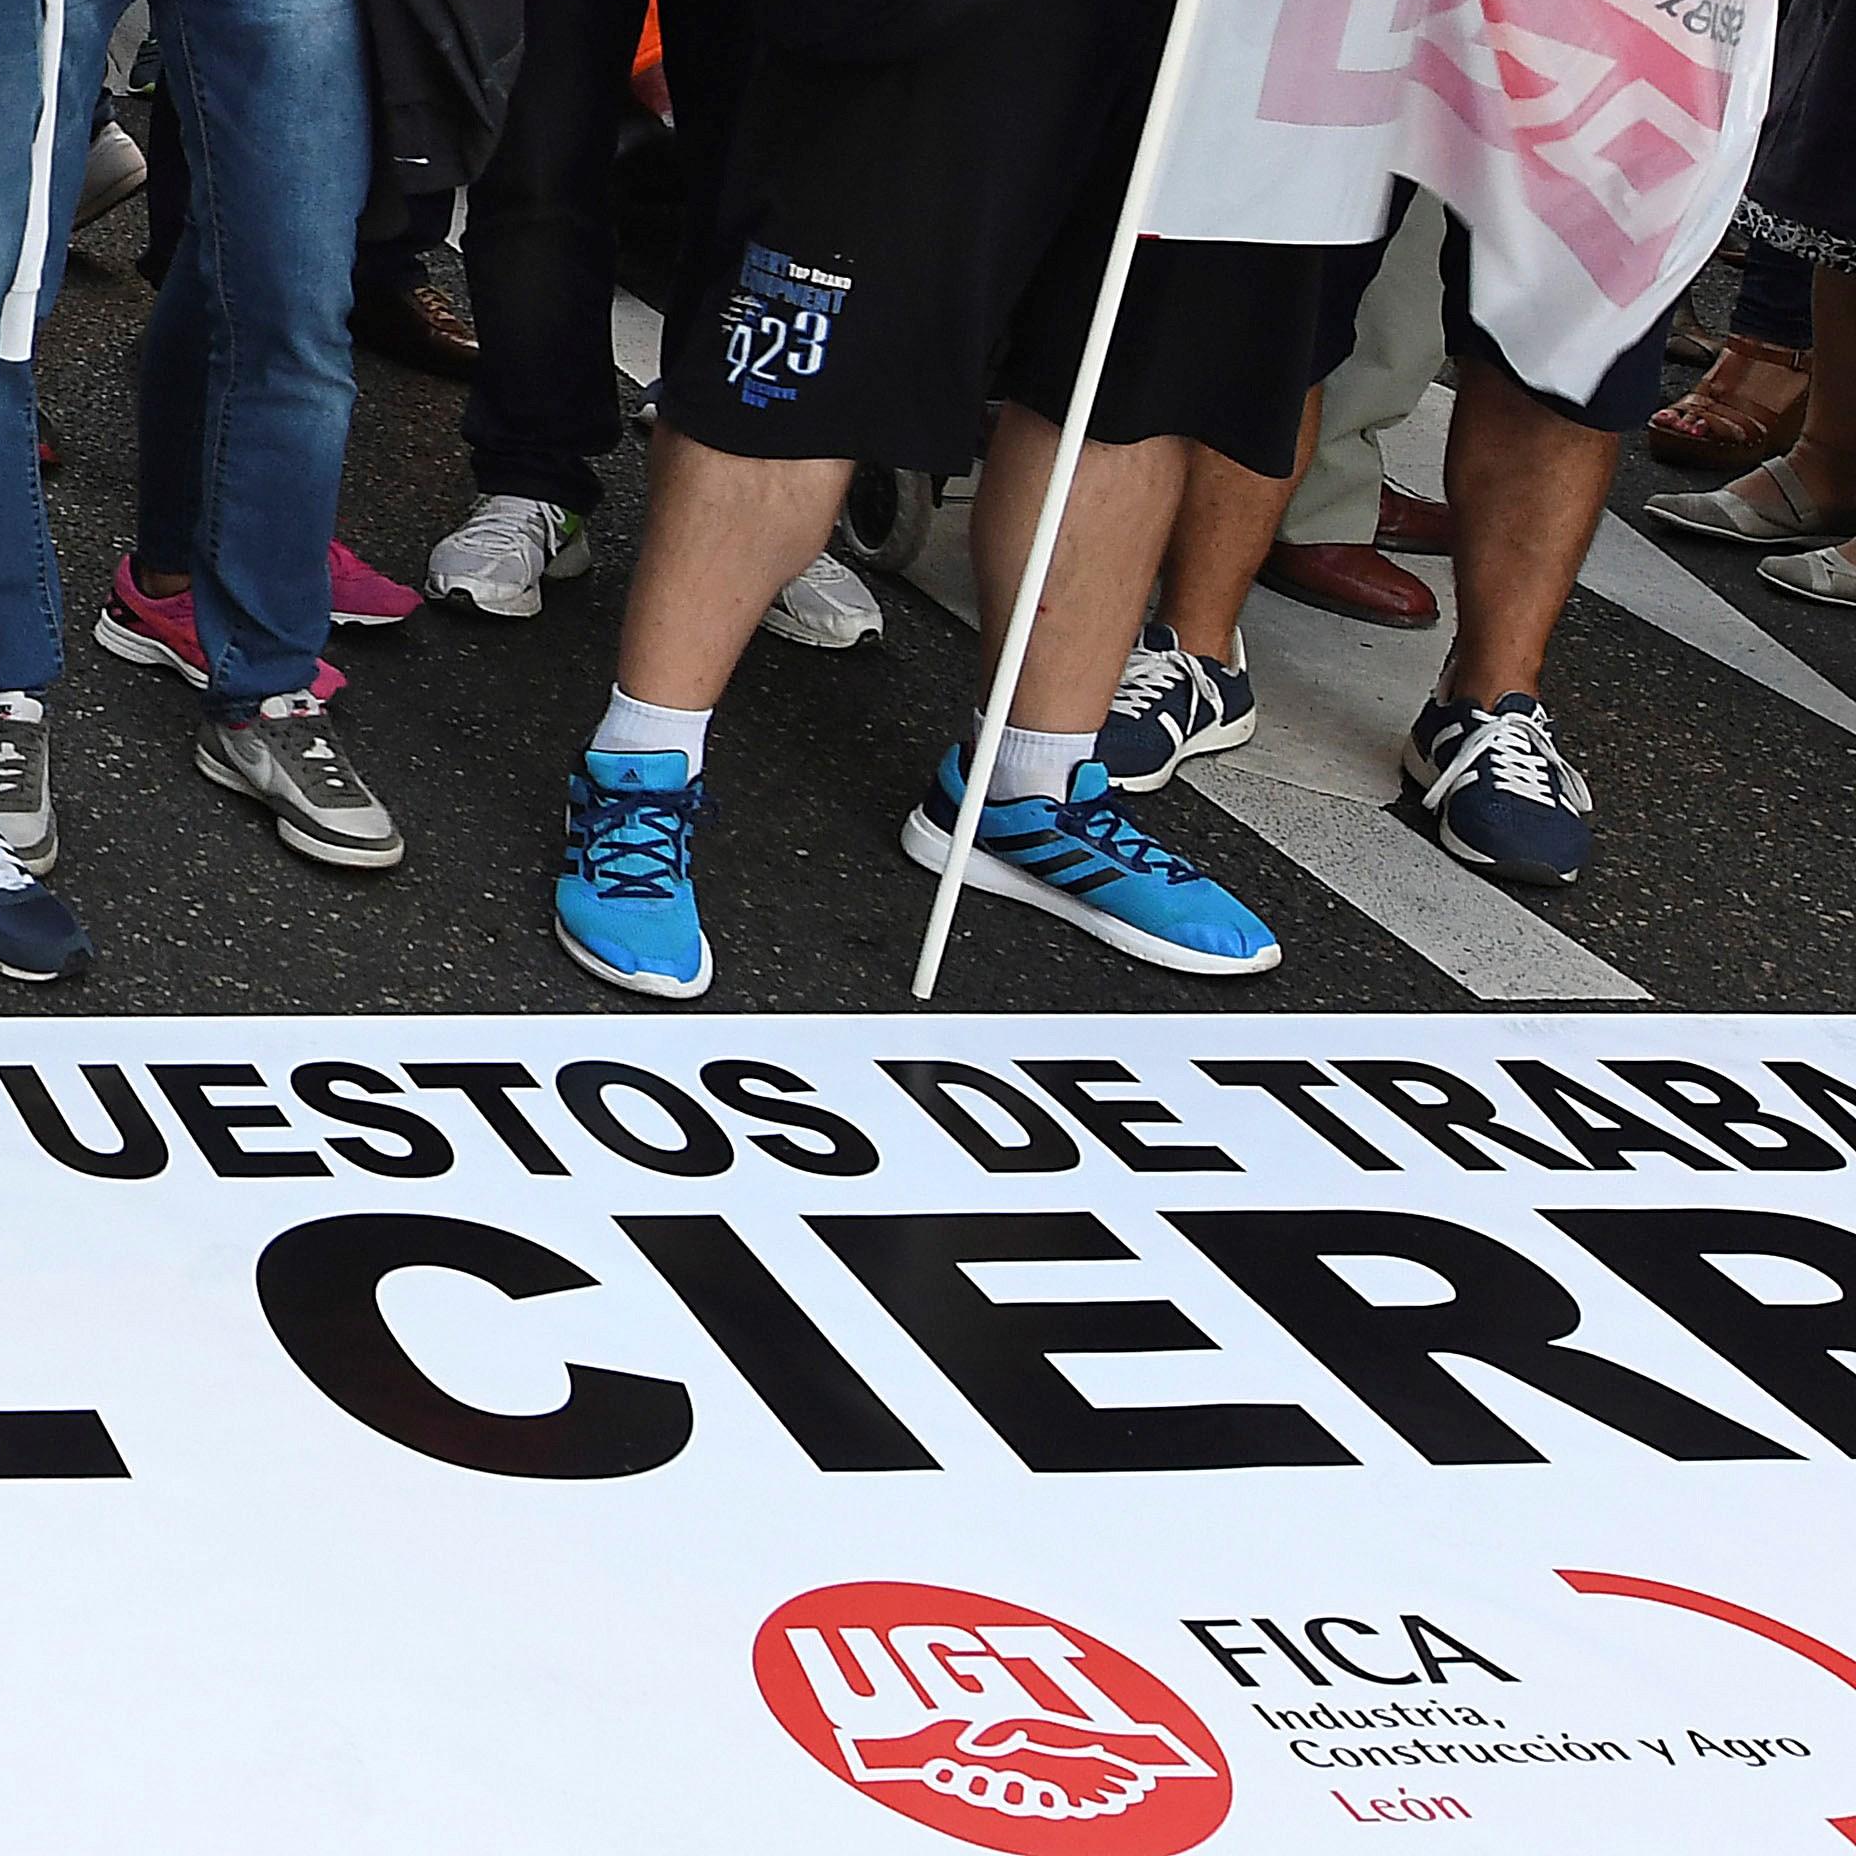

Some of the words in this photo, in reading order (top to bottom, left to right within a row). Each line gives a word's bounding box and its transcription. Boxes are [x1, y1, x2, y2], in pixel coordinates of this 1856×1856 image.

[873, 1059, 1246, 1173] DE
[783, 1623, 1138, 1732] UGT
[1178, 1613, 1522, 1687] FICA
[1250, 1701, 1509, 1734] Industria,
[1291, 1728, 1631, 1770] Construcción
[1646, 1740, 1679, 1770] y
[1687, 1728, 1813, 1772] Agro
[1333, 1787, 1473, 1825] León
